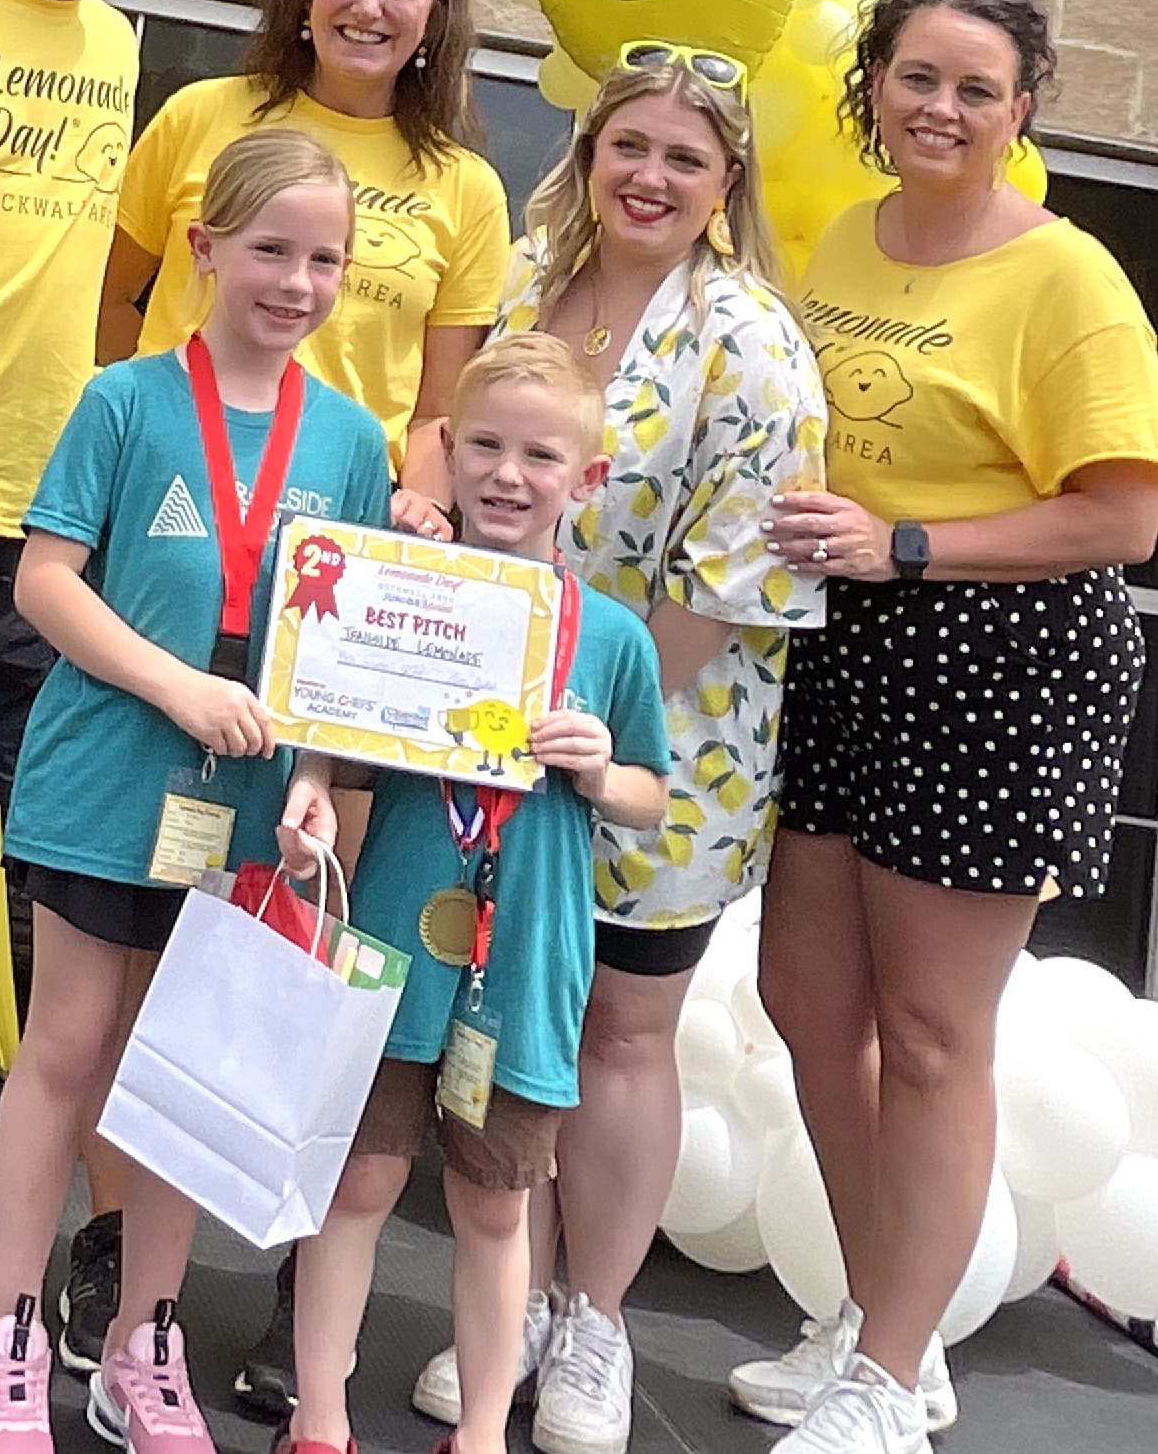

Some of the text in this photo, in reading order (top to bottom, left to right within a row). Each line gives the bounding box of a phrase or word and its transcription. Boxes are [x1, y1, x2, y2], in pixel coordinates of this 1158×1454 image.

[365, 606, 467, 642] BEST PITCH
[295, 686, 334, 704] YOUNG
[307, 703, 357, 720] ACADEMY
